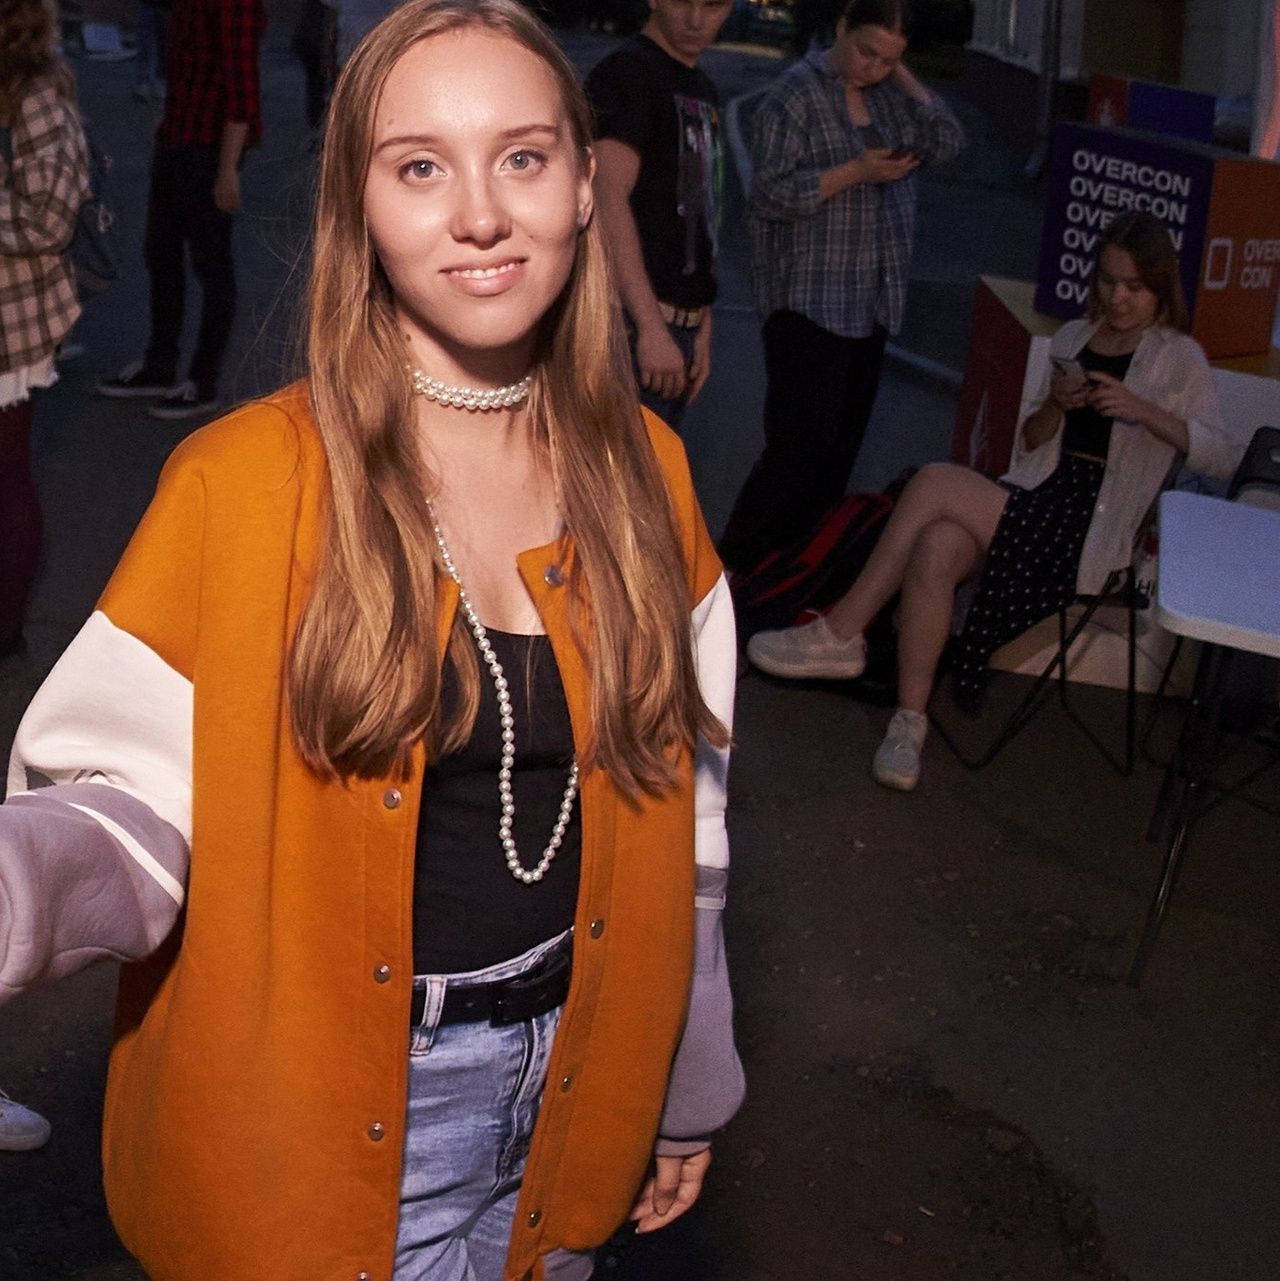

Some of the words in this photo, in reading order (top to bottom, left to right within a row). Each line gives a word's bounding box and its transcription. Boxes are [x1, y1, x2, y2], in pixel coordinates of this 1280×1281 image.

[1072, 149, 1191, 197] OVERCON
[1069, 176, 1188, 224] OVERCON
[1239, 266, 1272, 289] CON
